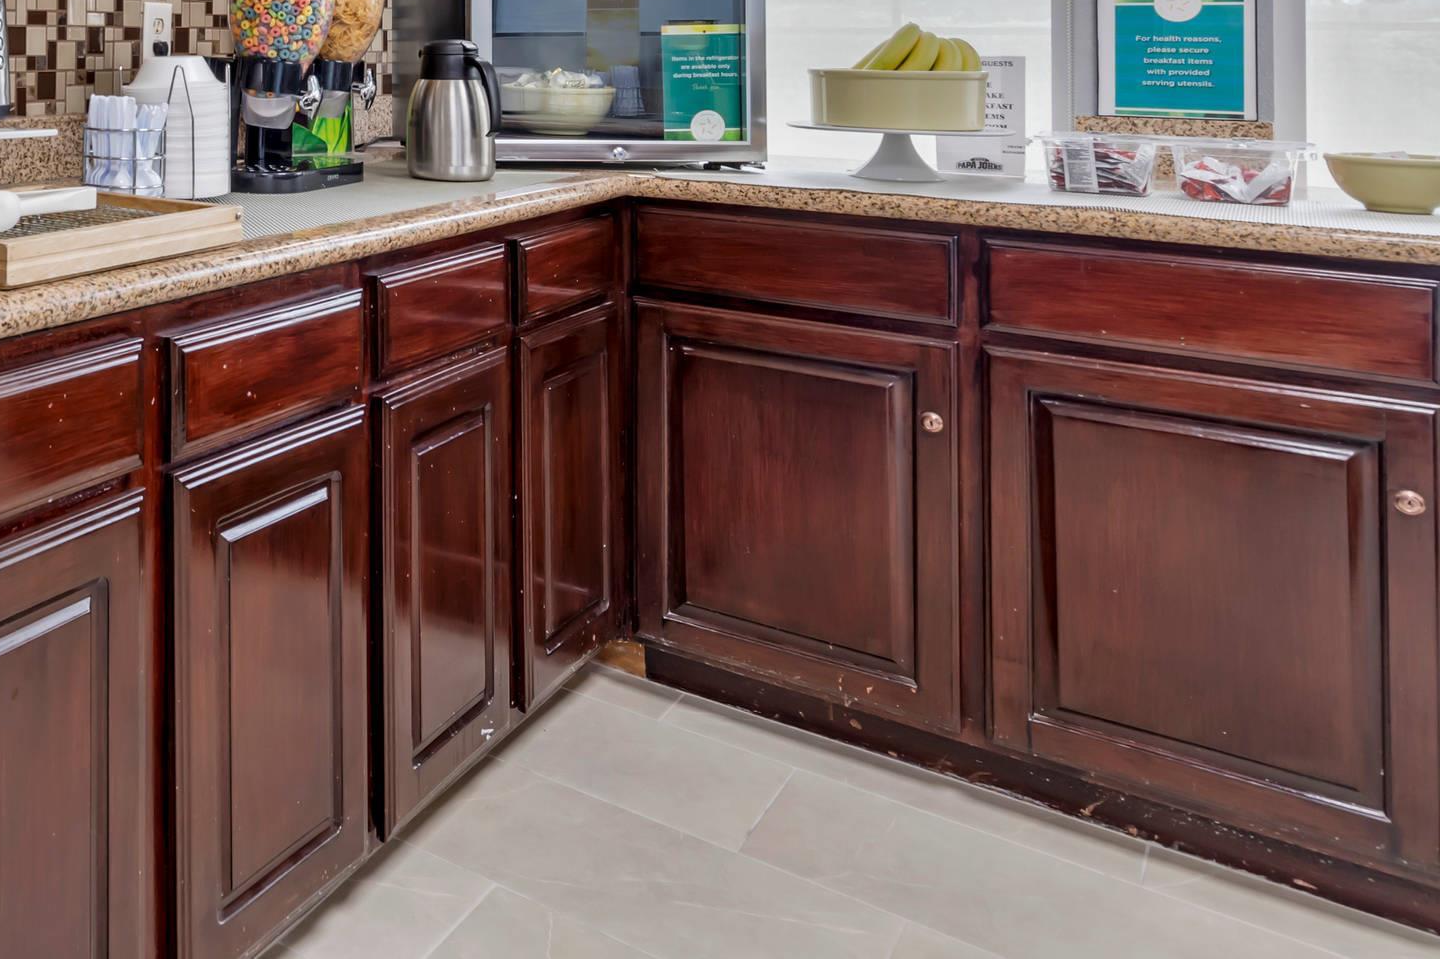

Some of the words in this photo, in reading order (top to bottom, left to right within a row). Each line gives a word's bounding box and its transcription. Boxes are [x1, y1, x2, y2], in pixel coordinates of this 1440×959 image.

[1146, 46, 1176, 54] please
[1143, 57, 1185, 65] breakfast
[1187, 57, 1213, 65] items
[1168, 69, 1210, 77] provided
[1142, 79, 1175, 87] serving
